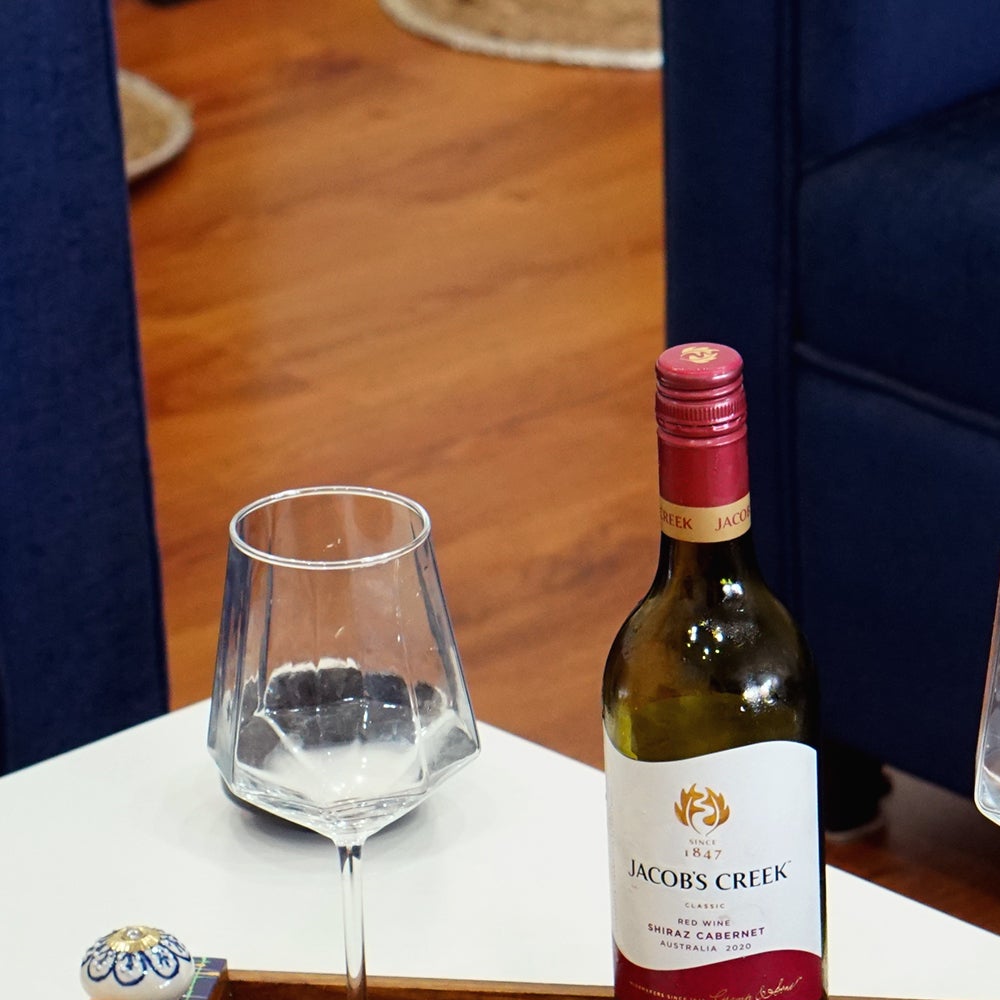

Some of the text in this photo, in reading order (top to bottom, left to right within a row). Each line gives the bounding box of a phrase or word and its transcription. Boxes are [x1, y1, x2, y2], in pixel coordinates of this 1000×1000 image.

[688, 838, 716, 846] SINCE
[684, 848, 722, 861] 1847
[628, 859, 788, 891] JACOB'S CREEK
[684, 902, 726, 910] CLASSIC
[677, 918, 731, 927] RED WINE
[647, 923, 765, 941] SHIRAZ CABERNET
[660, 940, 752, 953] AUSTRALIA 2020
